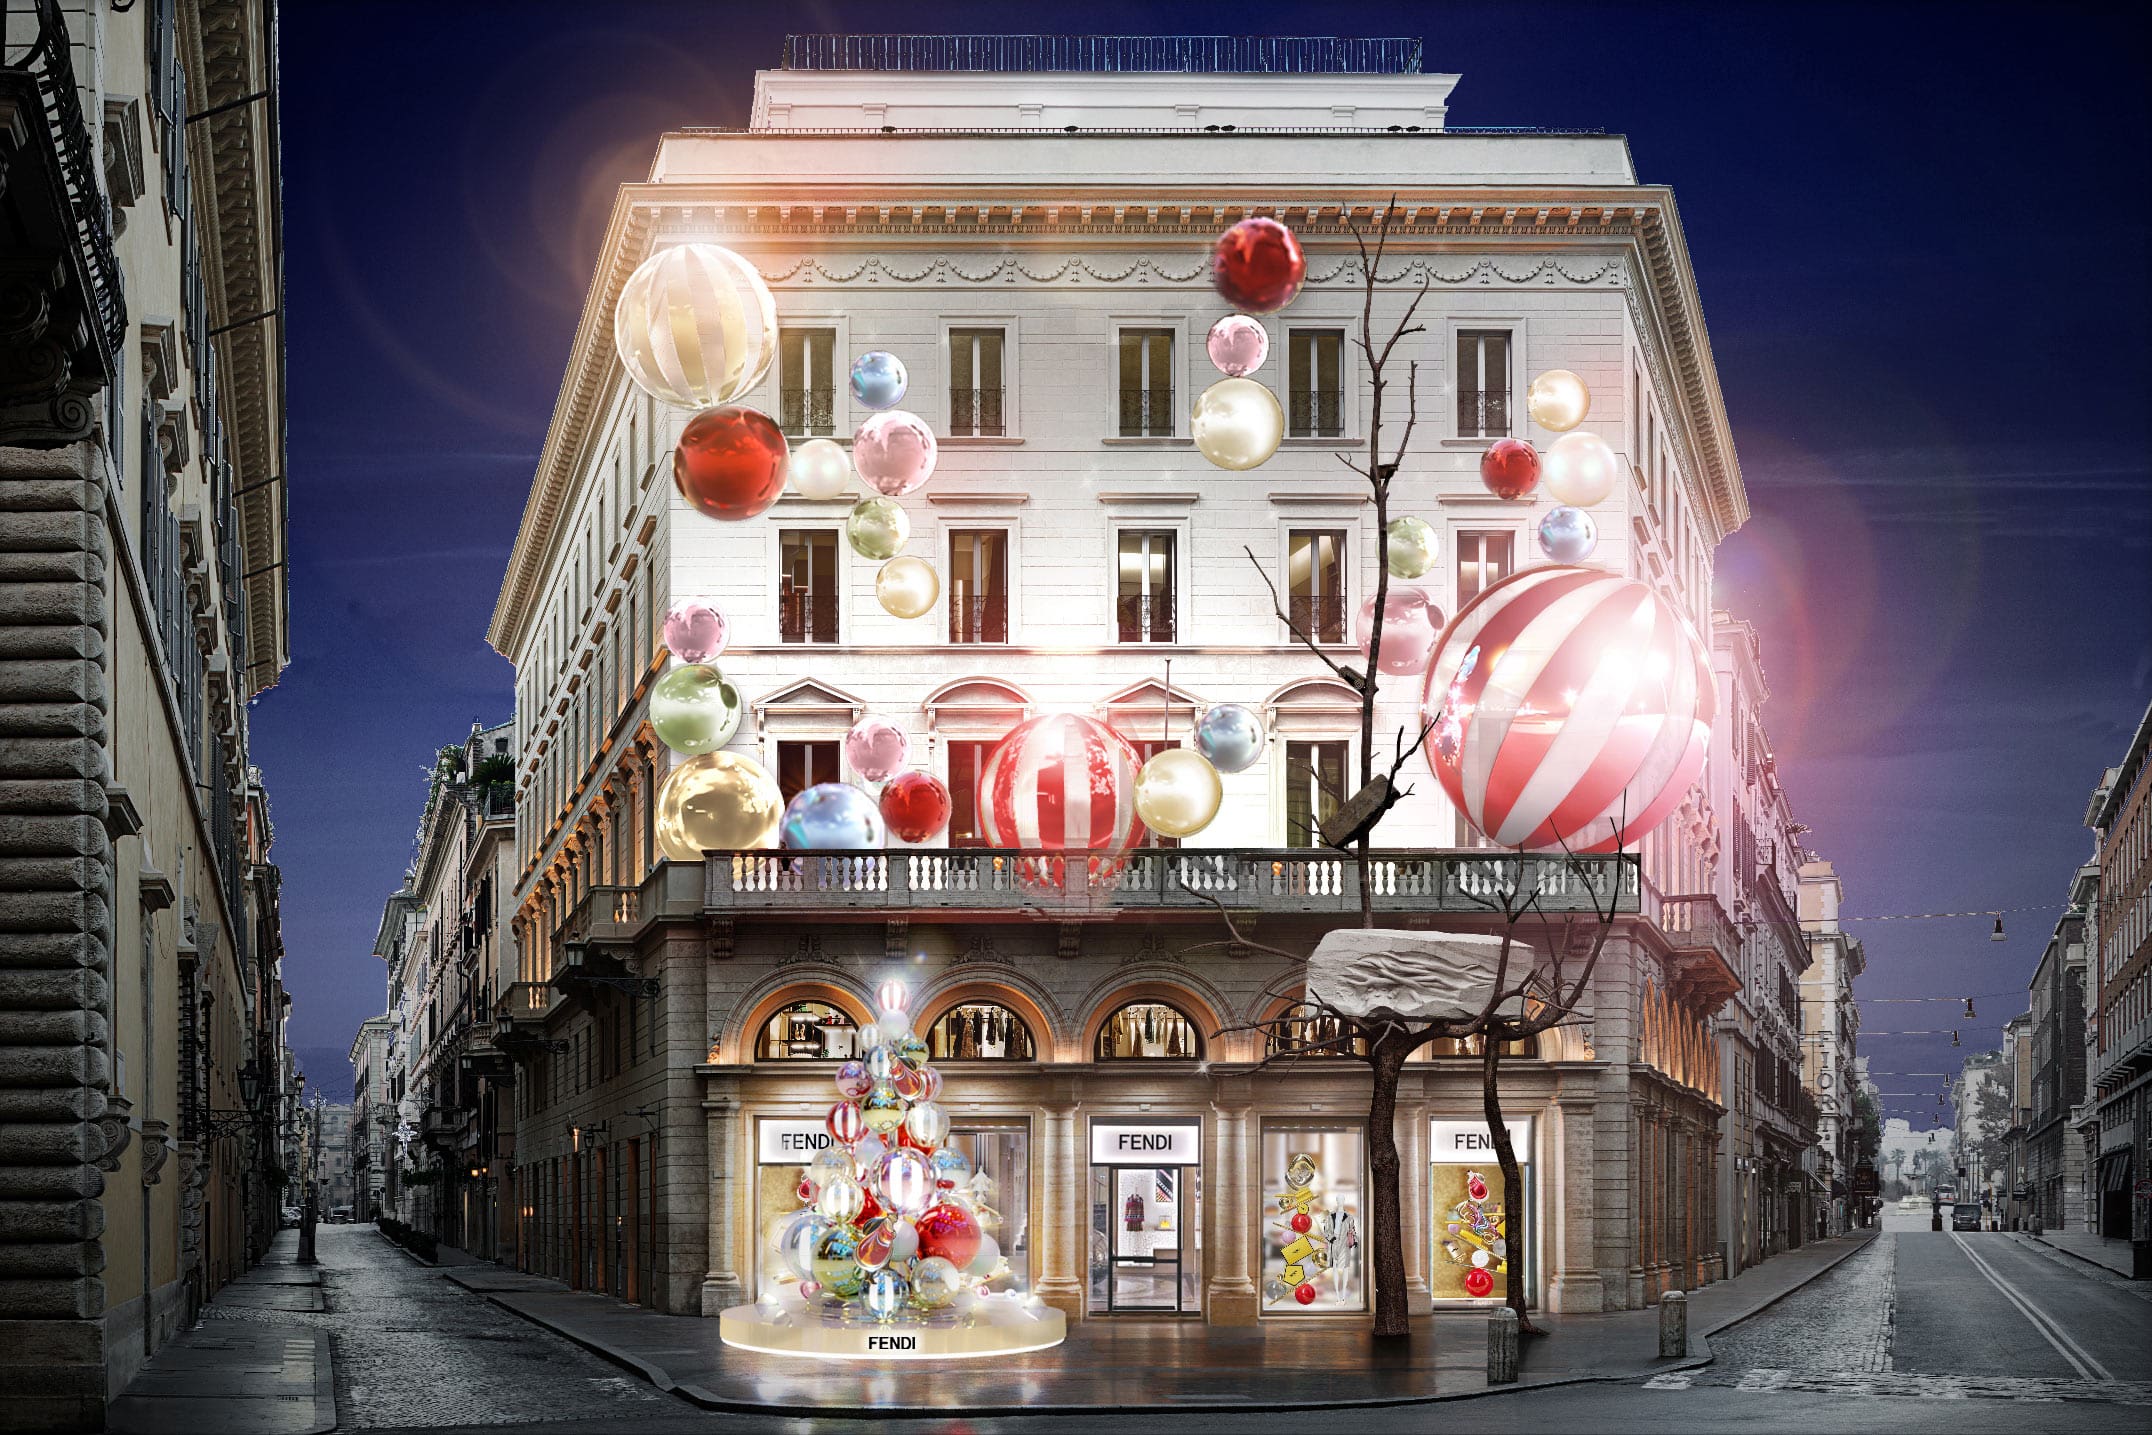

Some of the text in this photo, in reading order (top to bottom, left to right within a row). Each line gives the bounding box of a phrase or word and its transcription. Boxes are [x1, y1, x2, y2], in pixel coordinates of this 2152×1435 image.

[1118, 1133, 1172, 1150] FENDI
[1454, 1133, 1497, 1150] FEN
[868, 1336, 916, 1350] FENDI
